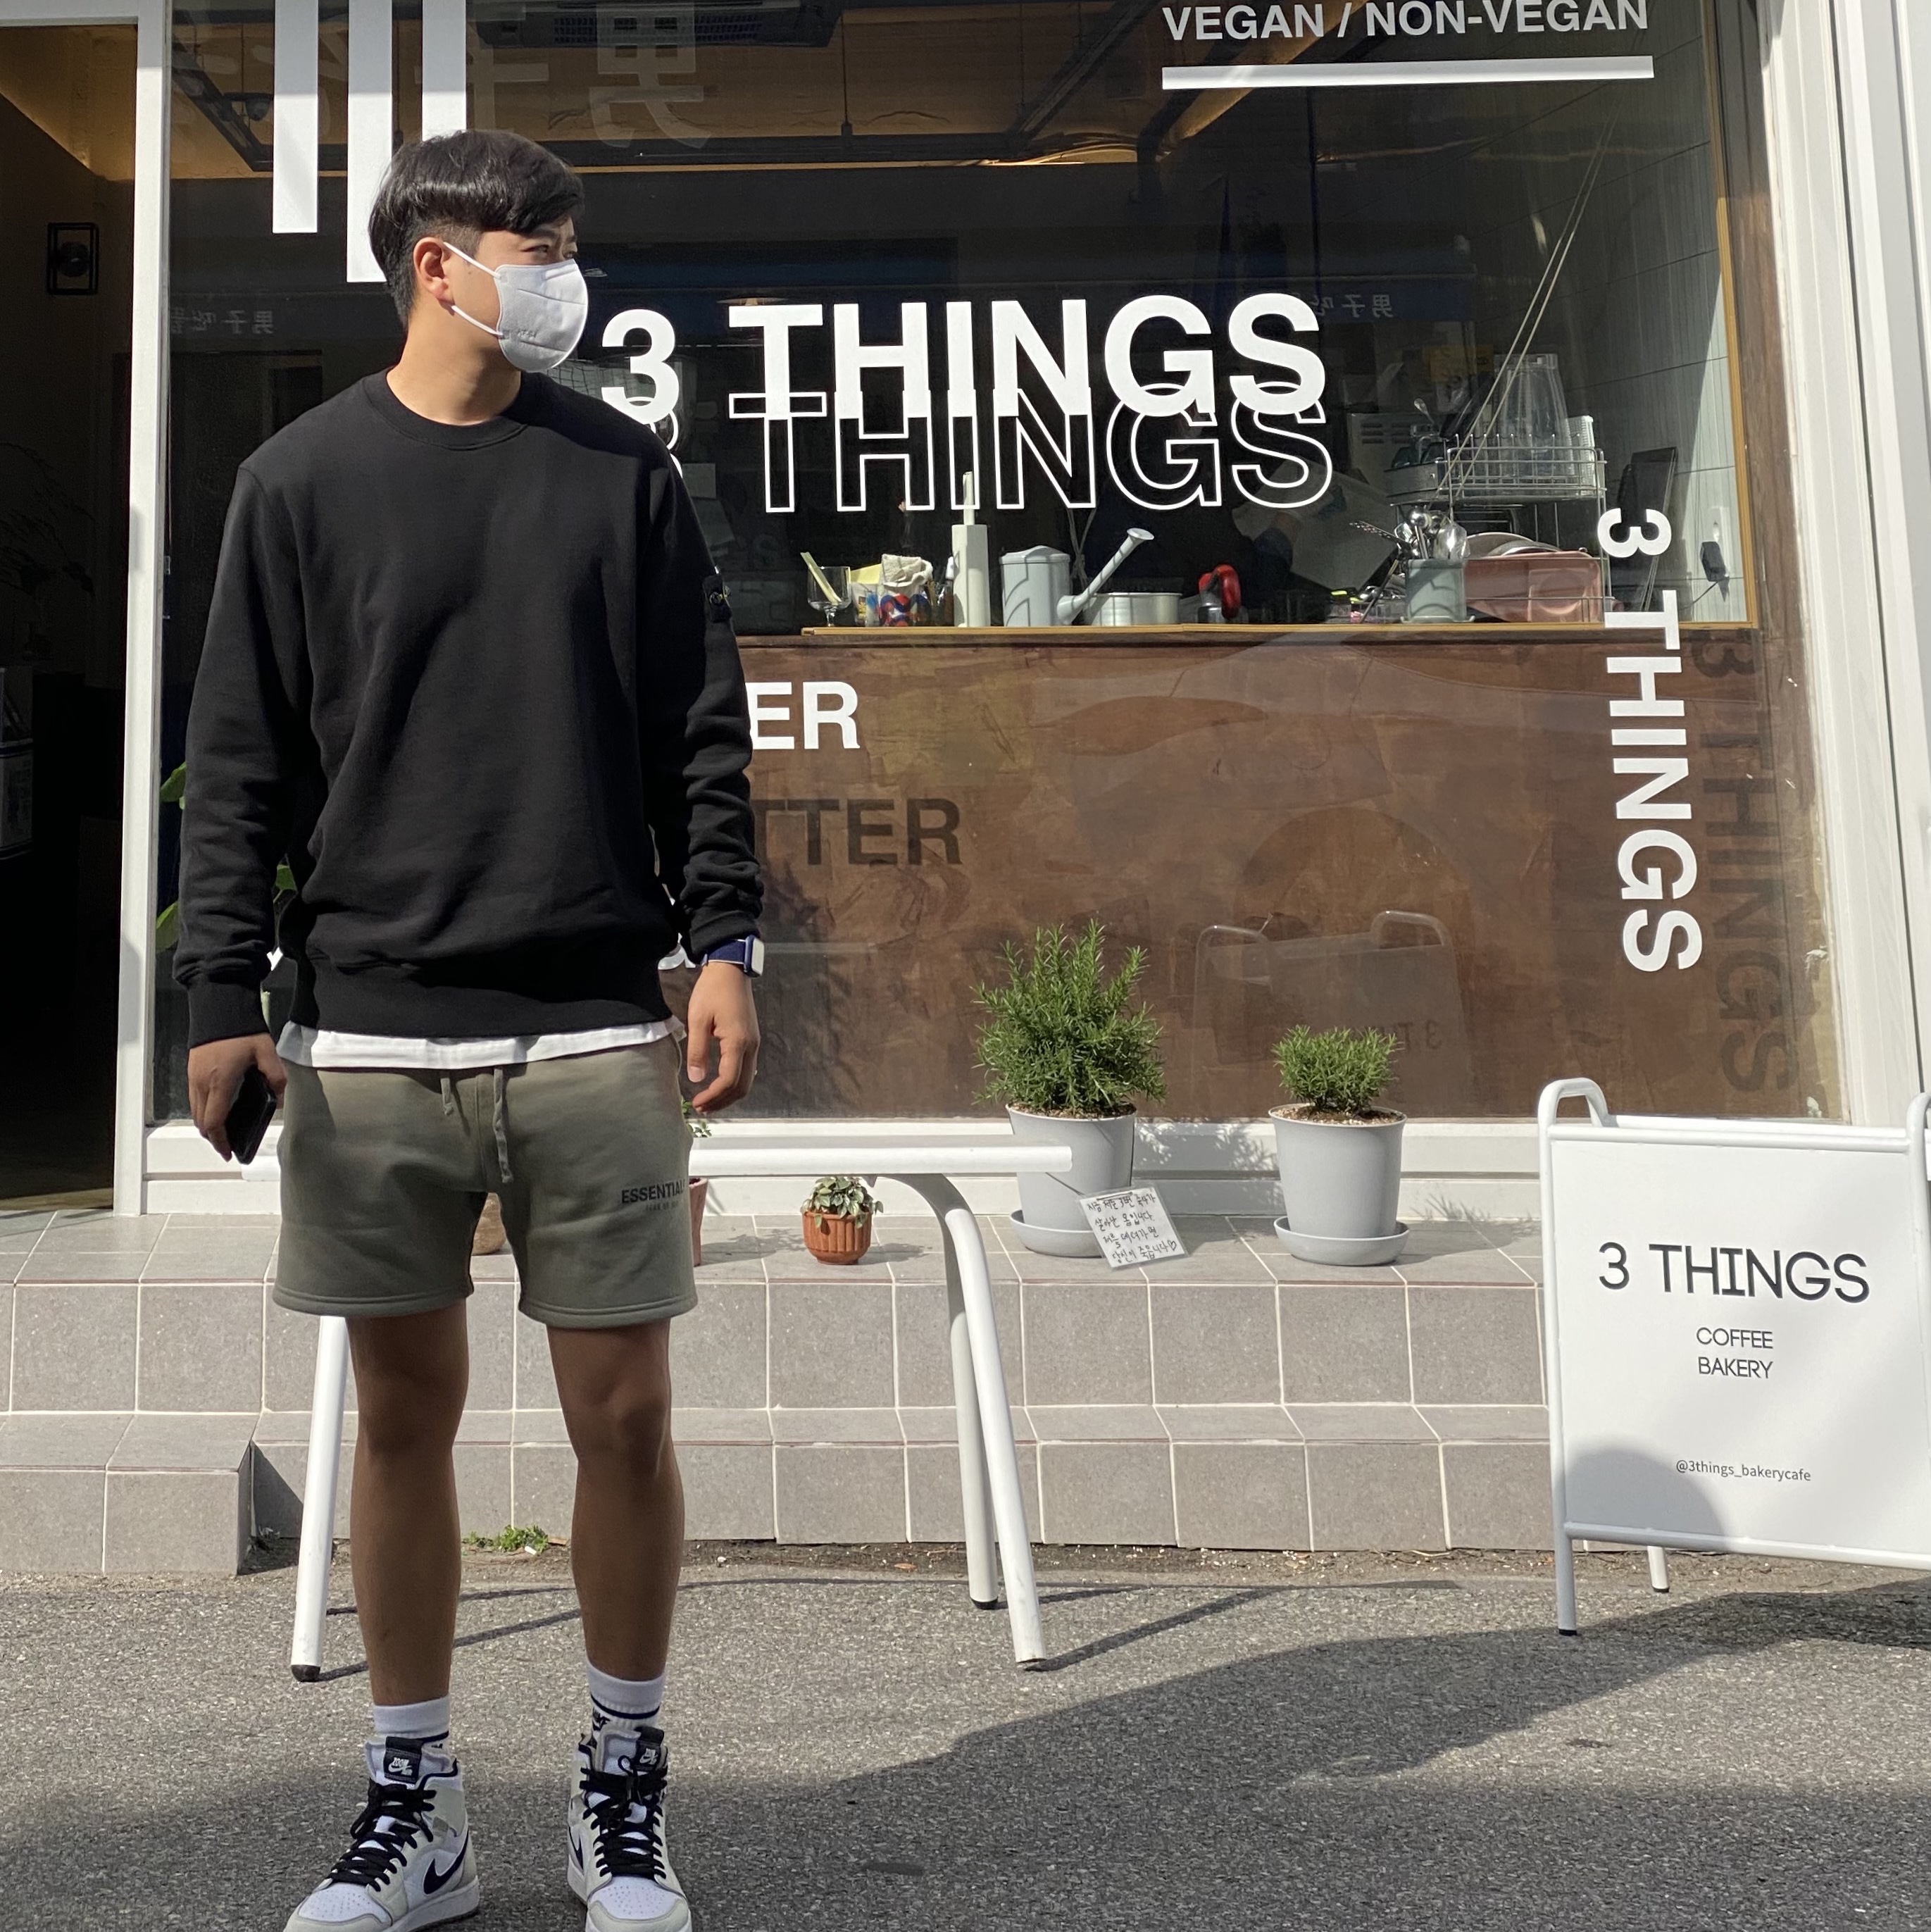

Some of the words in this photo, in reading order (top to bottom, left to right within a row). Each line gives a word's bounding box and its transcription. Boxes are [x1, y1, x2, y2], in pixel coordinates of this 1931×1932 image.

[1163, 3, 1324, 41] VEGAN
[1337, 1, 1350, 38] /
[1366, 0, 1649, 37] NON-VEGAN
[601, 309, 680, 423] 3
[729, 292, 1325, 420] THINGS
[729, 381, 1332, 513] THINGS
[1597, 508, 1672, 558] 3
[1604, 590, 1703, 972] THINGS
[1087, 1201, 1101, 1213] 지금
[1094, 1215, 1120, 1232] 살아난
[1112, 1249, 1137, 1264] 당신이
[1598, 1241, 1630, 1290] 3
[1648, 1243, 1870, 1304] THINGS
[1696, 1326, 1774, 1350] COFFEE
[1698, 1356, 1774, 1379] BAKERY
[1675, 1459, 1812, 1482] @3things_bakerycafe
